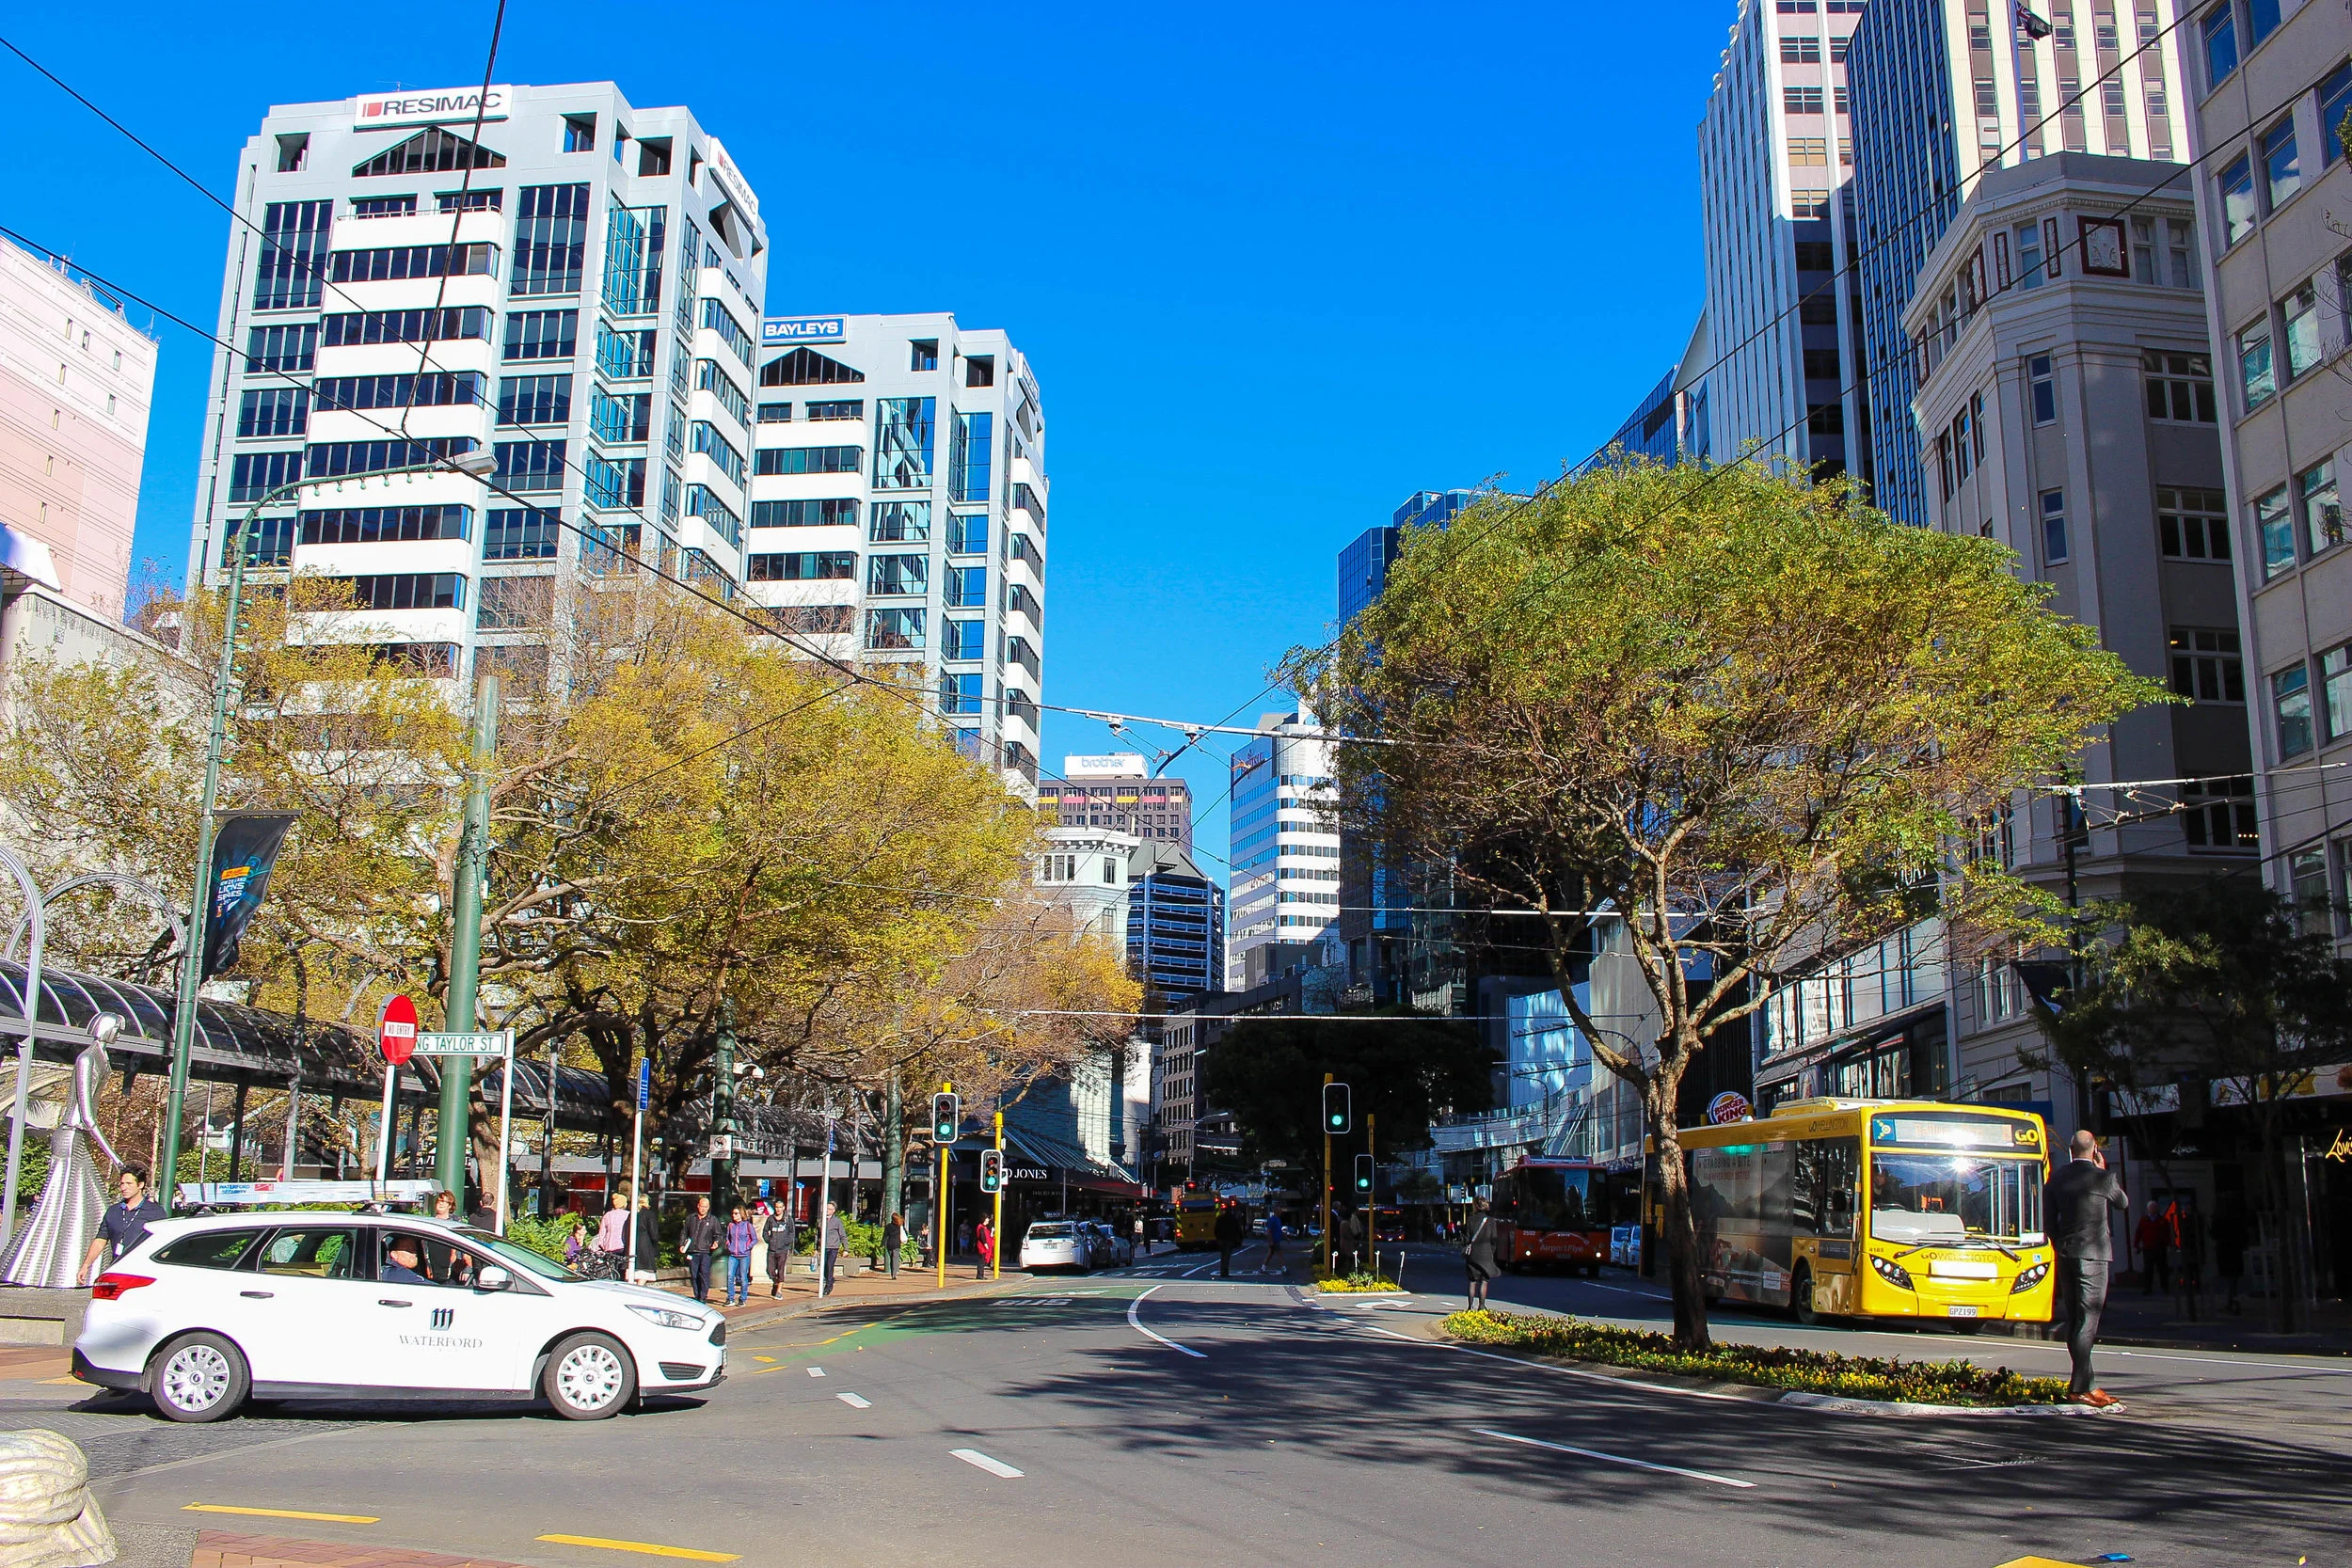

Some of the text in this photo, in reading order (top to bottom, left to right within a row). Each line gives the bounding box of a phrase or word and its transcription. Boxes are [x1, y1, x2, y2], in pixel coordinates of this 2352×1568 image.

[383, 93, 503, 116] RESIMAC
[723, 160, 756, 215] RESIMAC
[765, 322, 838, 337] BAYLEYS
[388, 1024, 411, 1035] NO ENTRY
[435, 1037, 474, 1052] TAYLOR
[480, 1037, 494, 1052] ST
[1714, 1098, 1743, 1116] BURGER
[1717, 1105, 1746, 1124] KING
[2014, 1129, 2038, 1143] GO
[1014, 1168, 1047, 1180] JONES
[1949, 1307, 1977, 1316] GPZ199
[399, 1335, 483, 1348] WATERFORD
